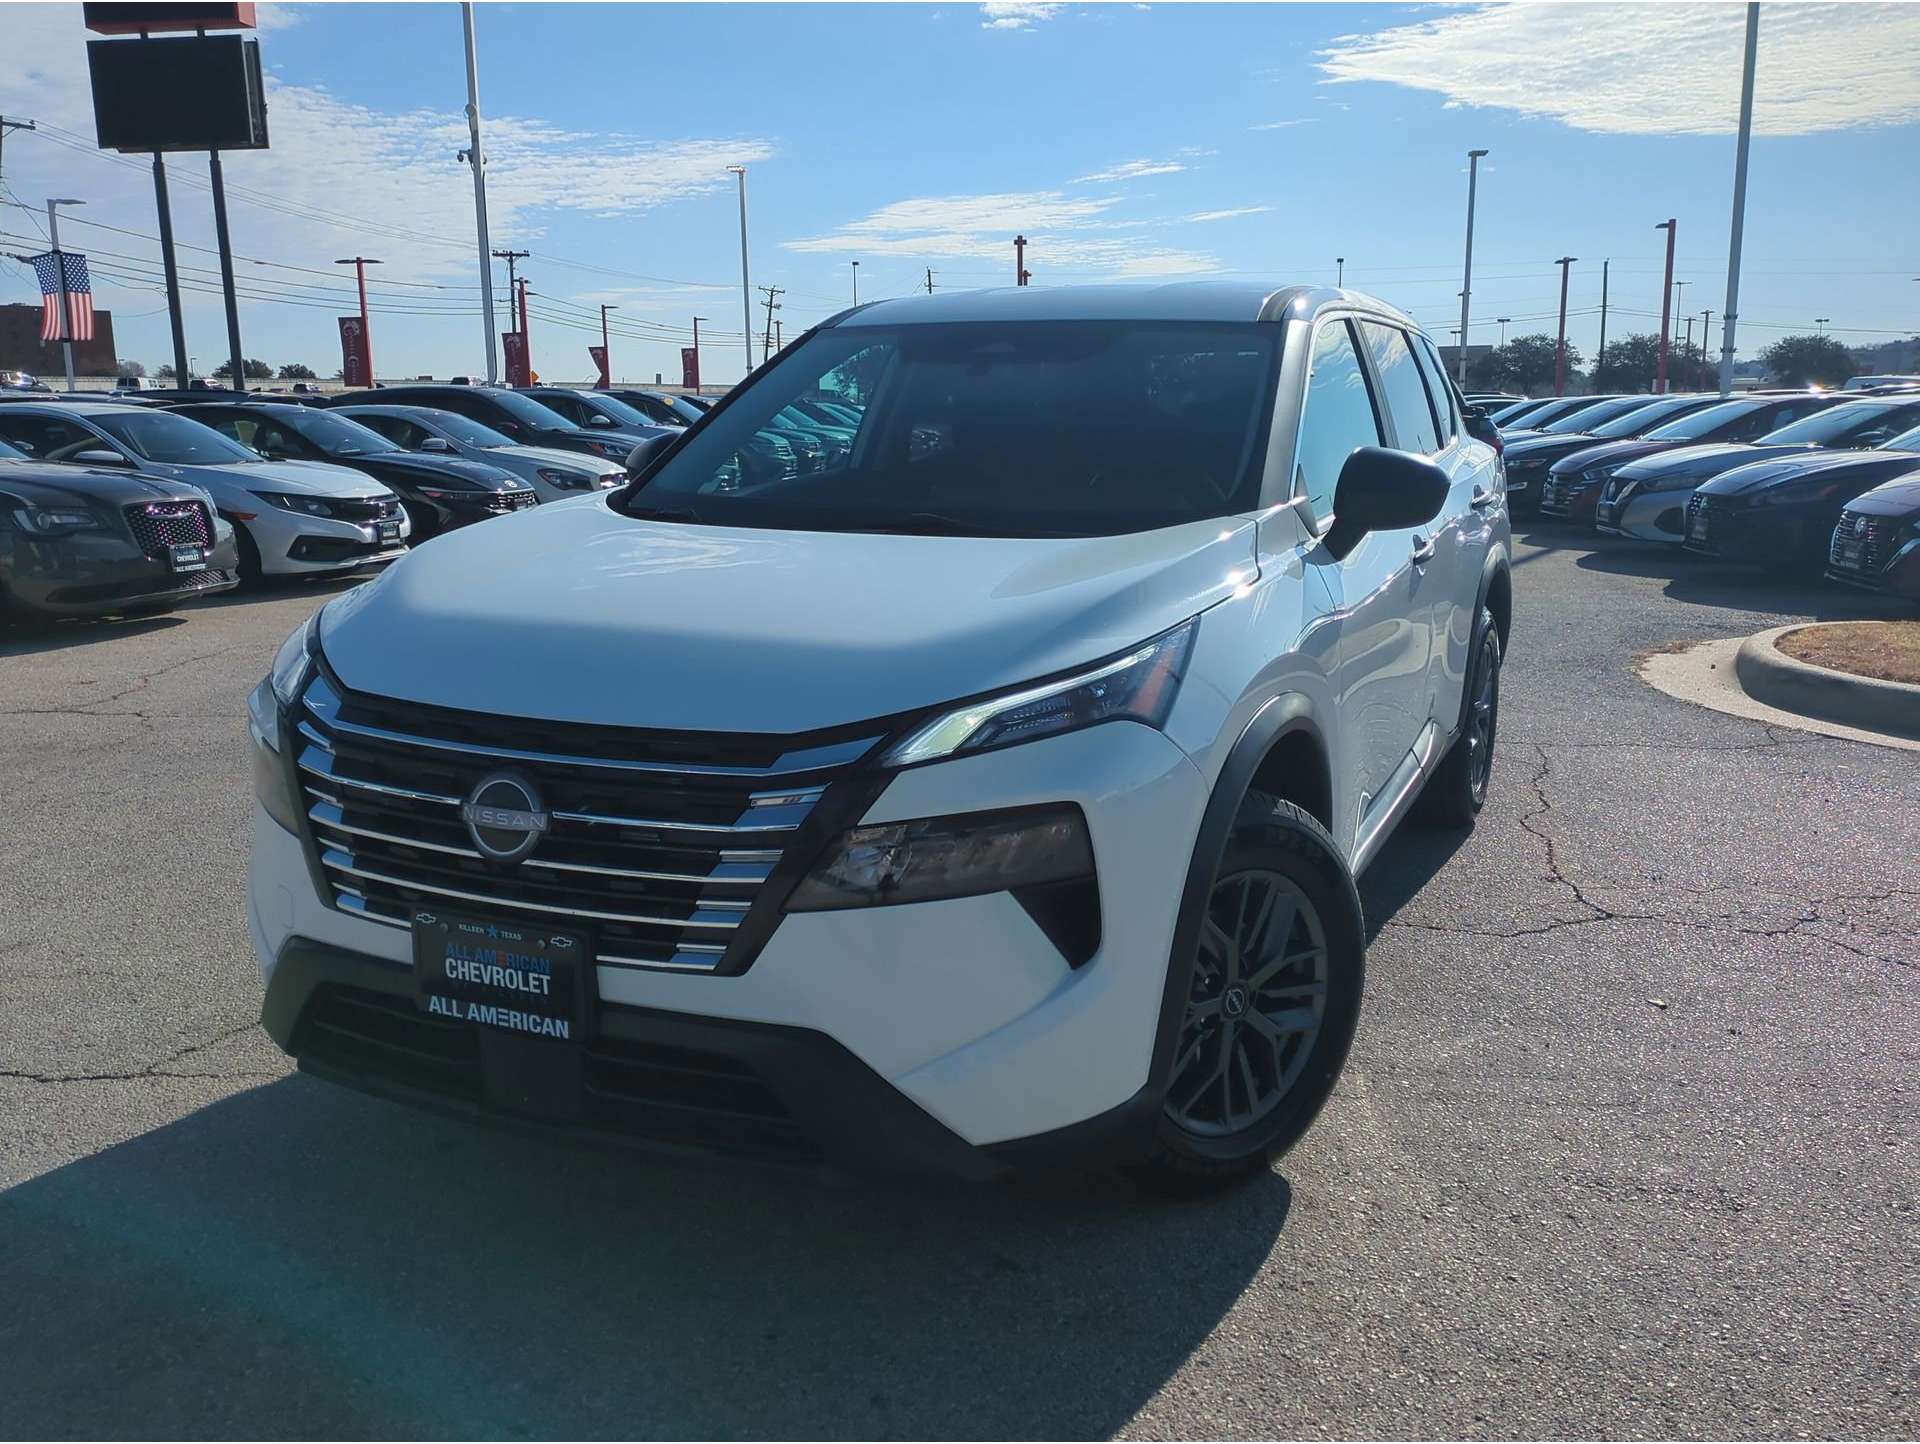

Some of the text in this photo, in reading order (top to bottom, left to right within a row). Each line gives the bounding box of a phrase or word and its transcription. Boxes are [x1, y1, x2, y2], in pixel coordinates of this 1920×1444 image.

[463, 806, 545, 828] NISSAN
[458, 923, 522, 941] KILLEEN TEXAS
[446, 944, 551, 972] ALL AMERICAN
[445, 957, 551, 995] CHEVROLET
[428, 995, 569, 1039] ALL AMERICAN
